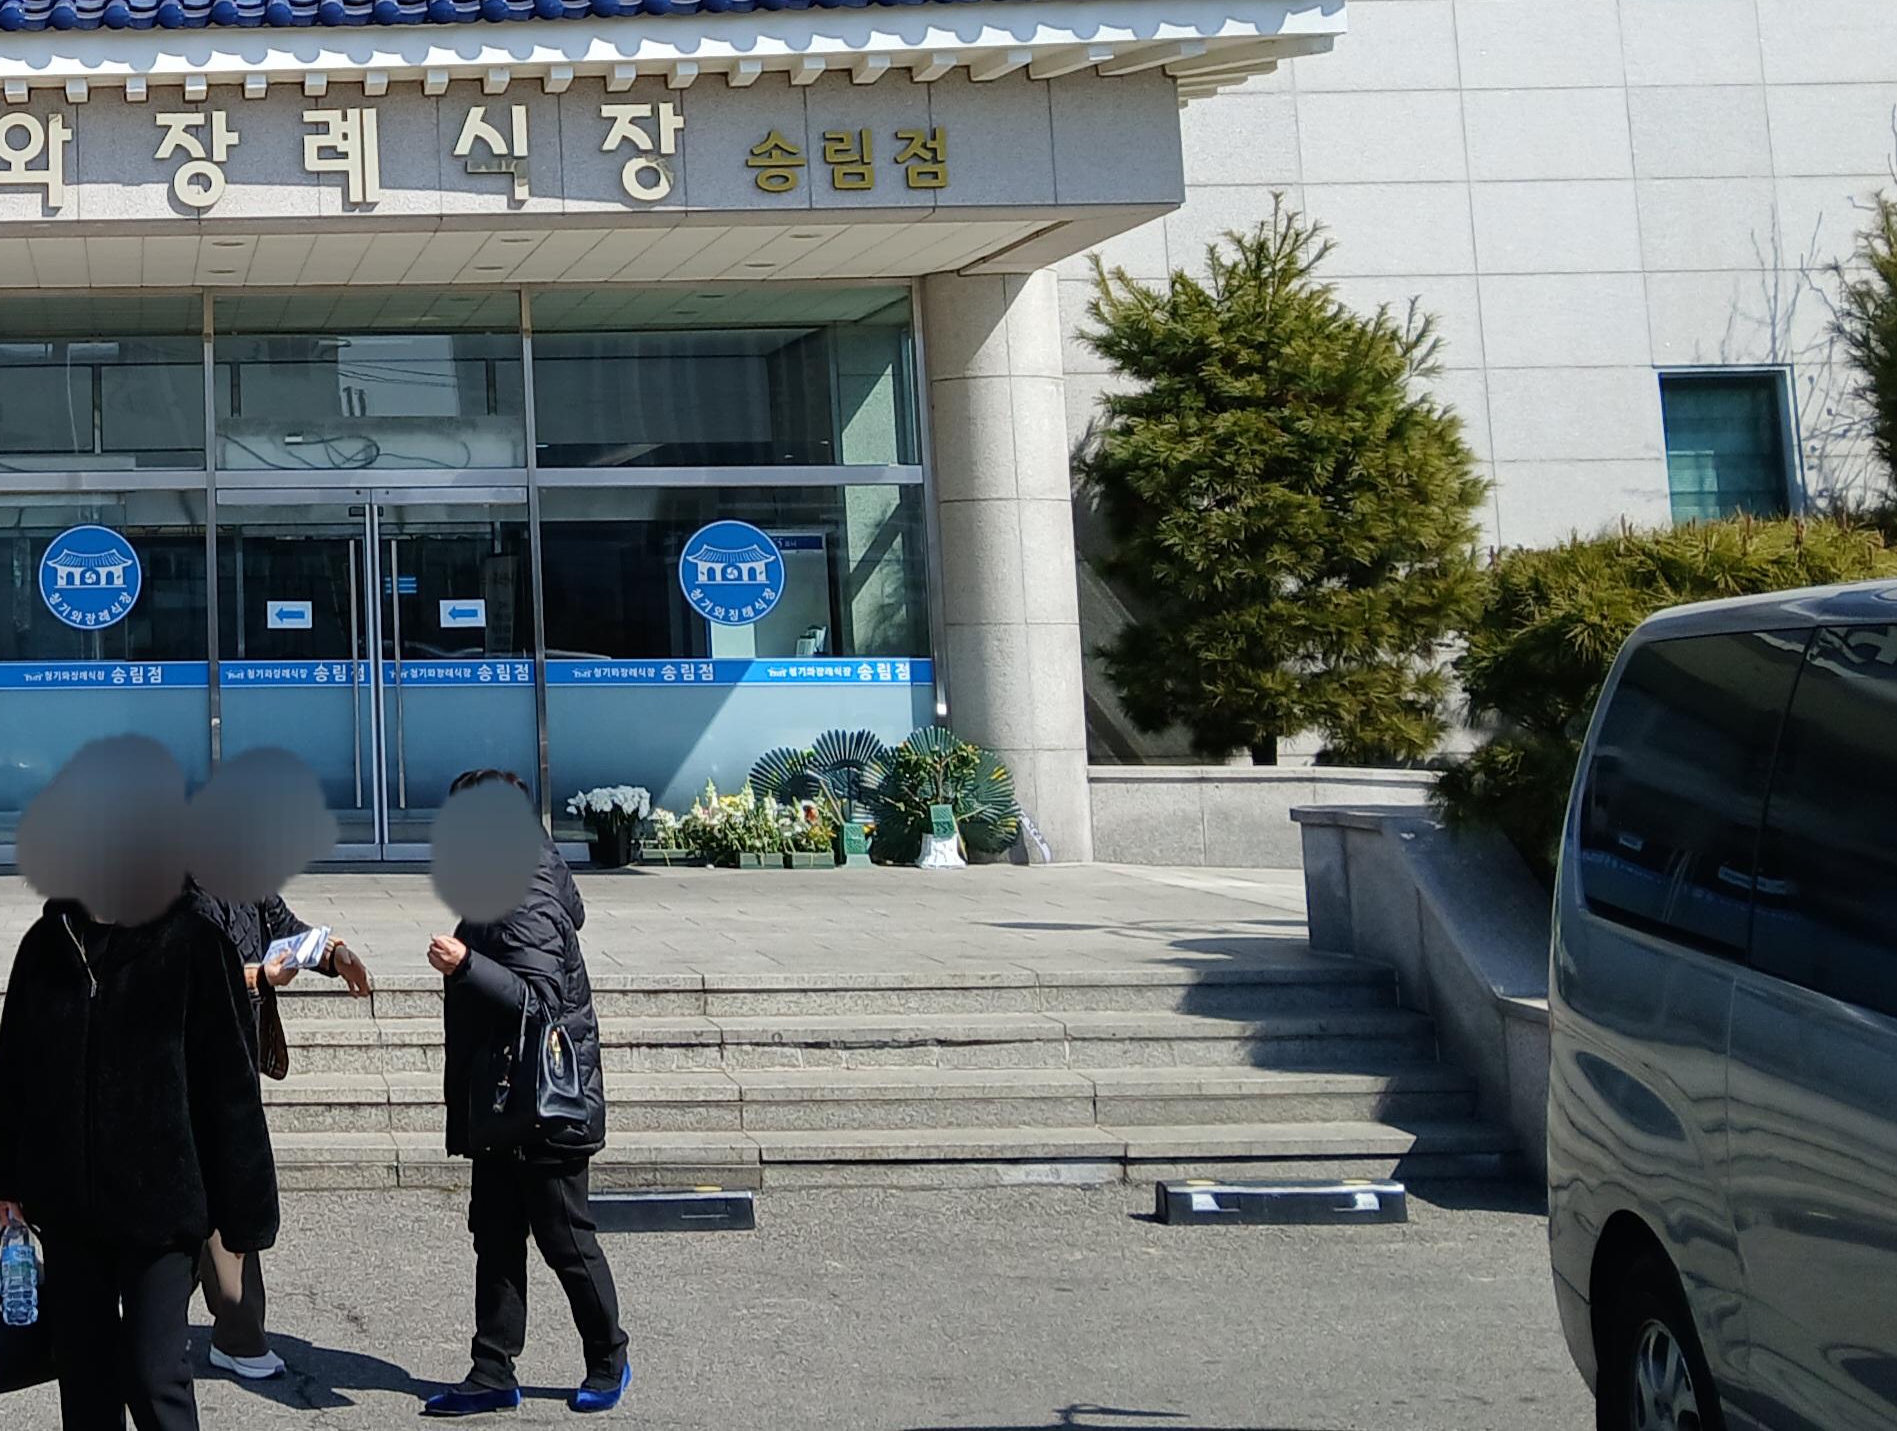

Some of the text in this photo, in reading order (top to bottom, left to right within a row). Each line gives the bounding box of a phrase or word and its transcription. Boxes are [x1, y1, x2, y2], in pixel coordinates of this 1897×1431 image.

[746, 126, 947, 192] 송림점
[111, 666, 162, 684] 송림점
[477, 663, 529, 681] 송림점
[661, 663, 714, 681] 송림점
[857, 662, 910, 680] 송림점
